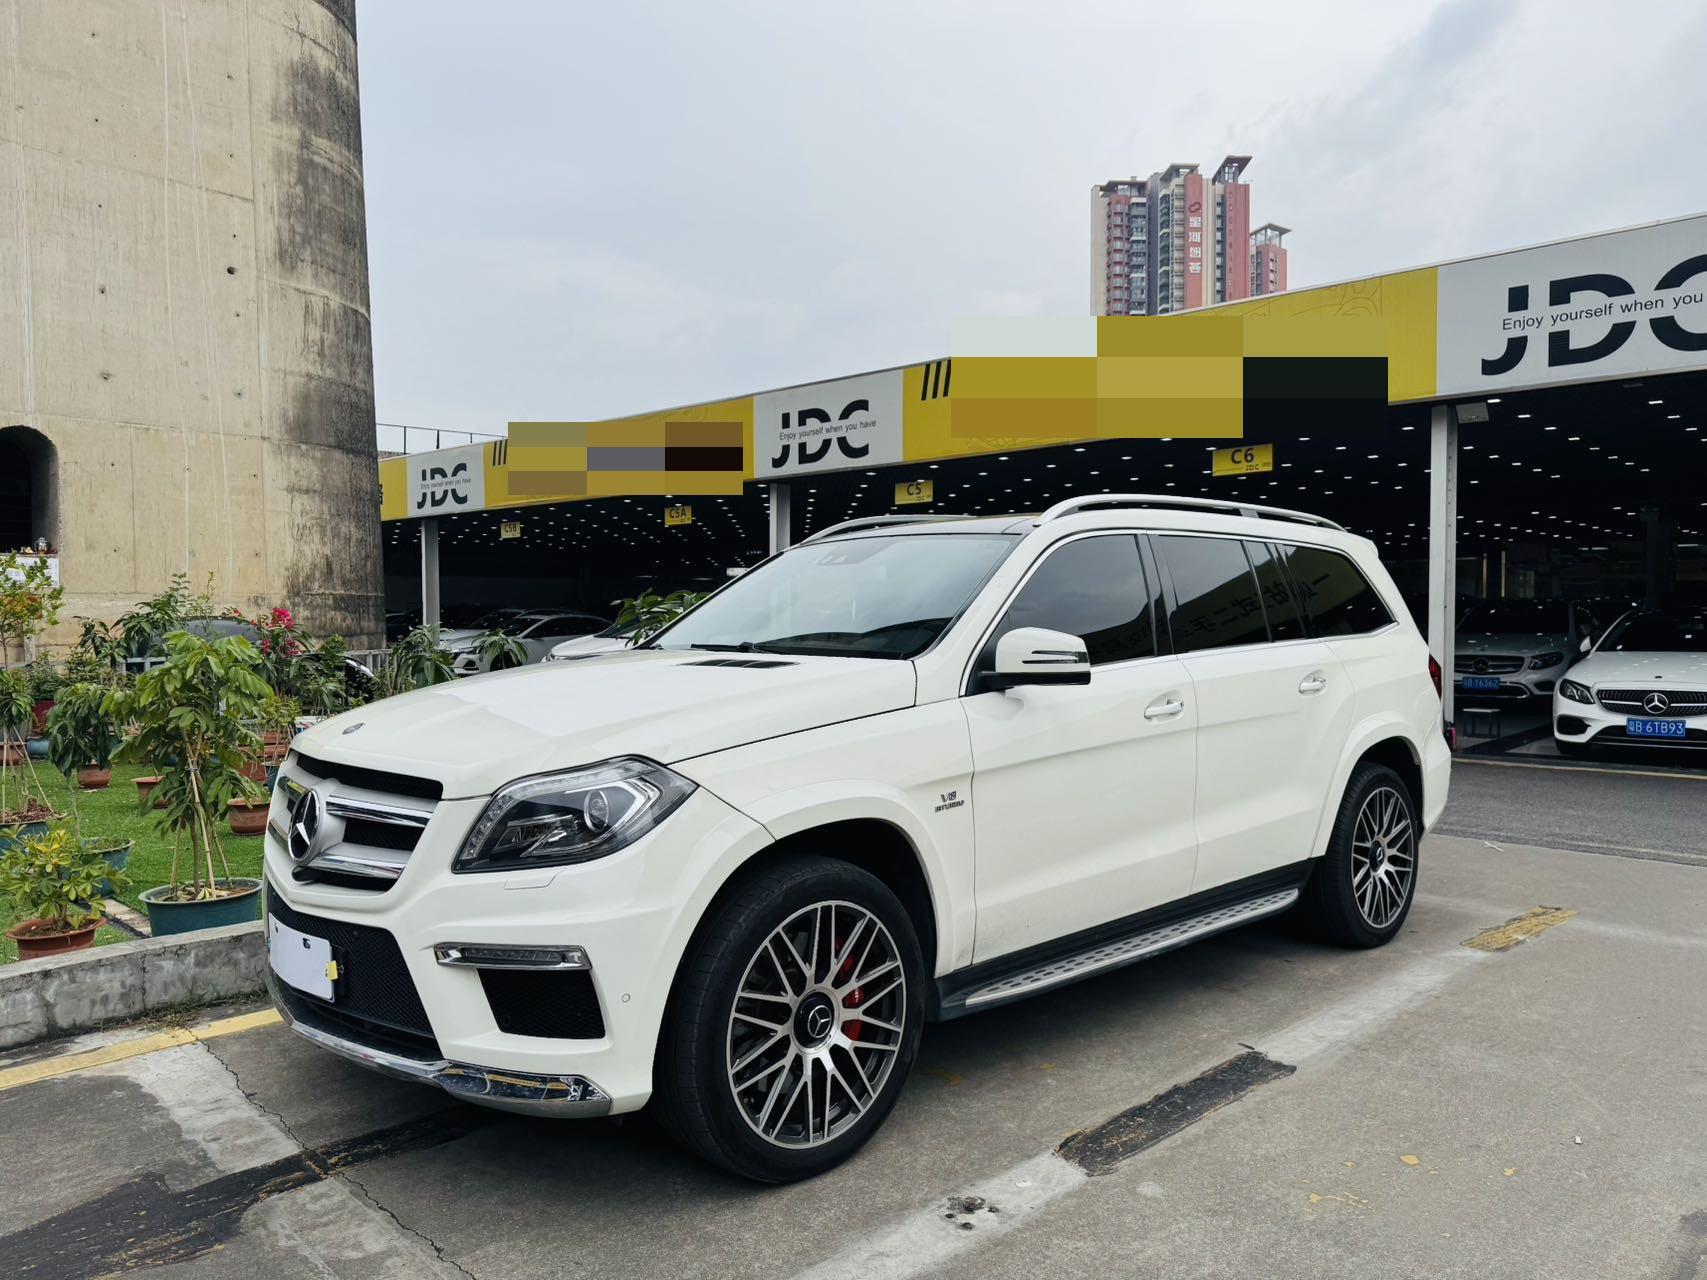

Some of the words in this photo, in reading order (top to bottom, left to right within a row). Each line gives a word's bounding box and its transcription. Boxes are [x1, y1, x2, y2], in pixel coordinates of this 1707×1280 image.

[1503, 316, 1544, 331] Enjoy
[1551, 302, 1613, 326] yourself
[1620, 299, 1664, 313] when
[1673, 293, 1703, 309] you
[772, 399, 869, 469] JDC
[780, 431, 797, 441] Enjoy
[798, 425, 824, 439] yourself
[825, 424, 843, 434] when
[845, 422, 857, 432] you
[860, 420, 877, 428] have
[1231, 448, 1254, 464] C6
[417, 462, 468, 509] JDC
[907, 483, 921, 496] C5
[670, 507, 686, 518] C5A
[941, 791, 957, 803] V8
